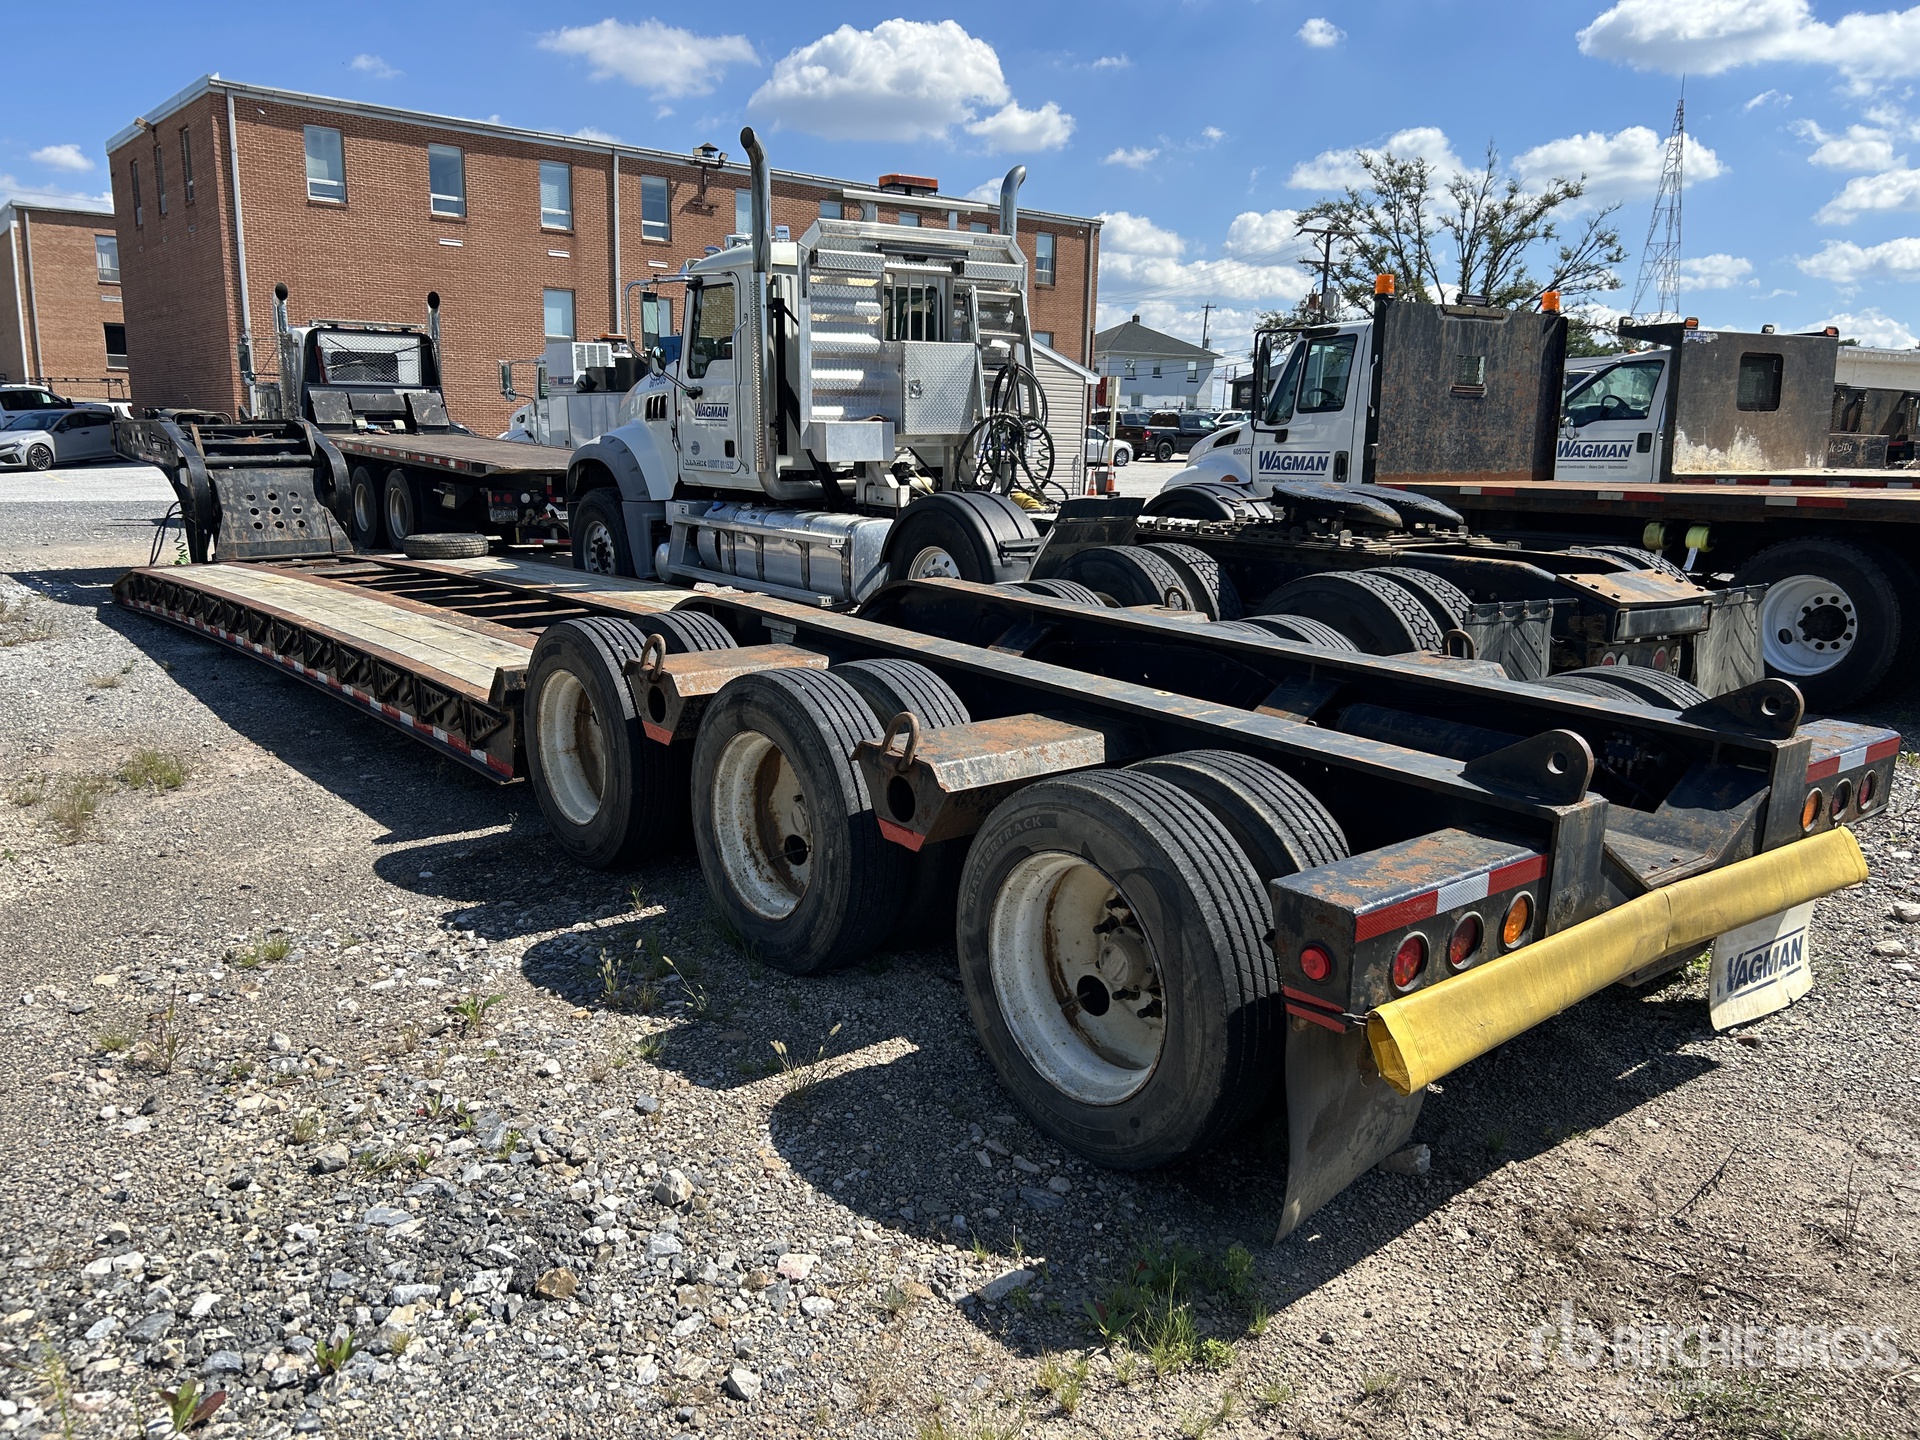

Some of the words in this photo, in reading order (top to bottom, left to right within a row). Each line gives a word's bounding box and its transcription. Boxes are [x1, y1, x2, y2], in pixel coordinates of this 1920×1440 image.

[694, 402, 729, 418] WAGMAN
[1557, 440, 1632, 458] WAGMAN
[1258, 450, 1329, 471] WAGMAN
[967, 815, 1042, 908] MASTERTRACK
